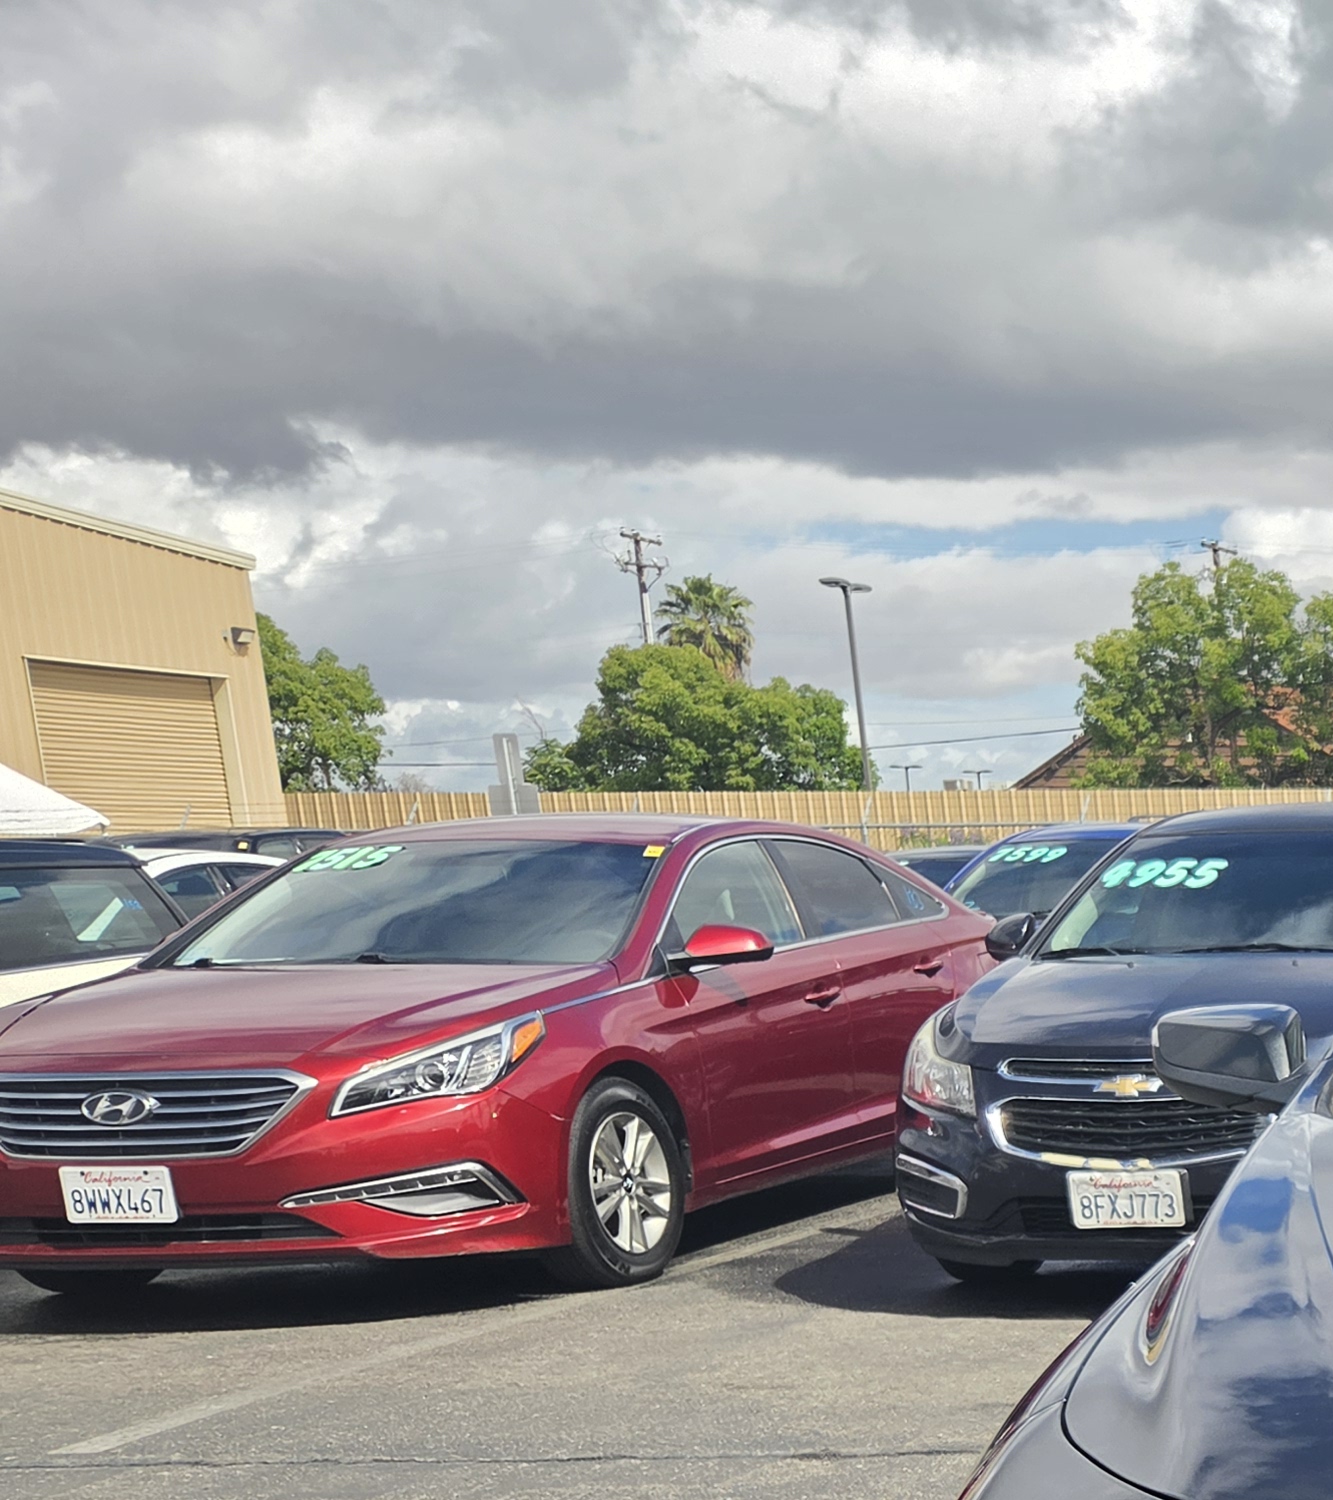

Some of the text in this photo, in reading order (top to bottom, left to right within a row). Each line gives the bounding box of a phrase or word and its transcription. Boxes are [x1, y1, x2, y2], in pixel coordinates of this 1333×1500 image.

[1101, 857, 1229, 889] 4955
[84, 1171, 151, 1187] California
[71, 1189, 163, 1214] 8WWX467
[1080, 1193, 1176, 1219] 8FXJ773
